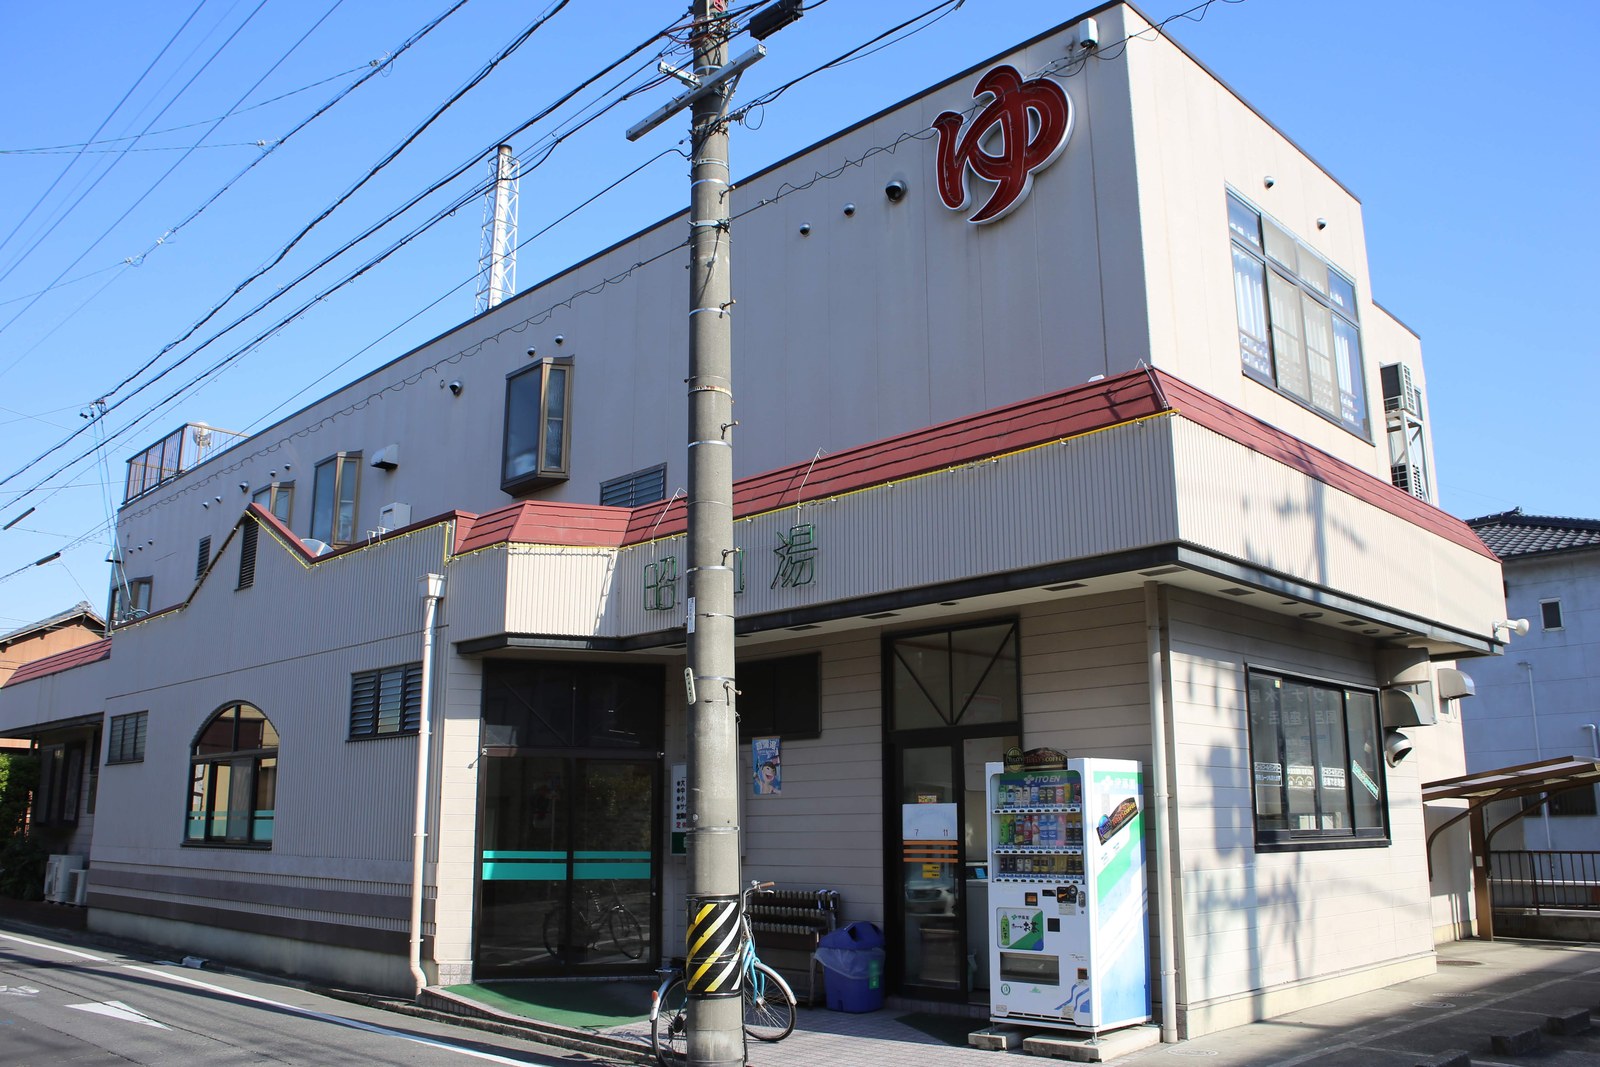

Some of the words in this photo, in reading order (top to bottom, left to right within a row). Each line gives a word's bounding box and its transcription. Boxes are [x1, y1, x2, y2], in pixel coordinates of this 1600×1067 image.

[932, 64, 1075, 224] ゆ
[644, 522, 818, 611] 昭湯
[1049, 775, 1061, 783] EN
